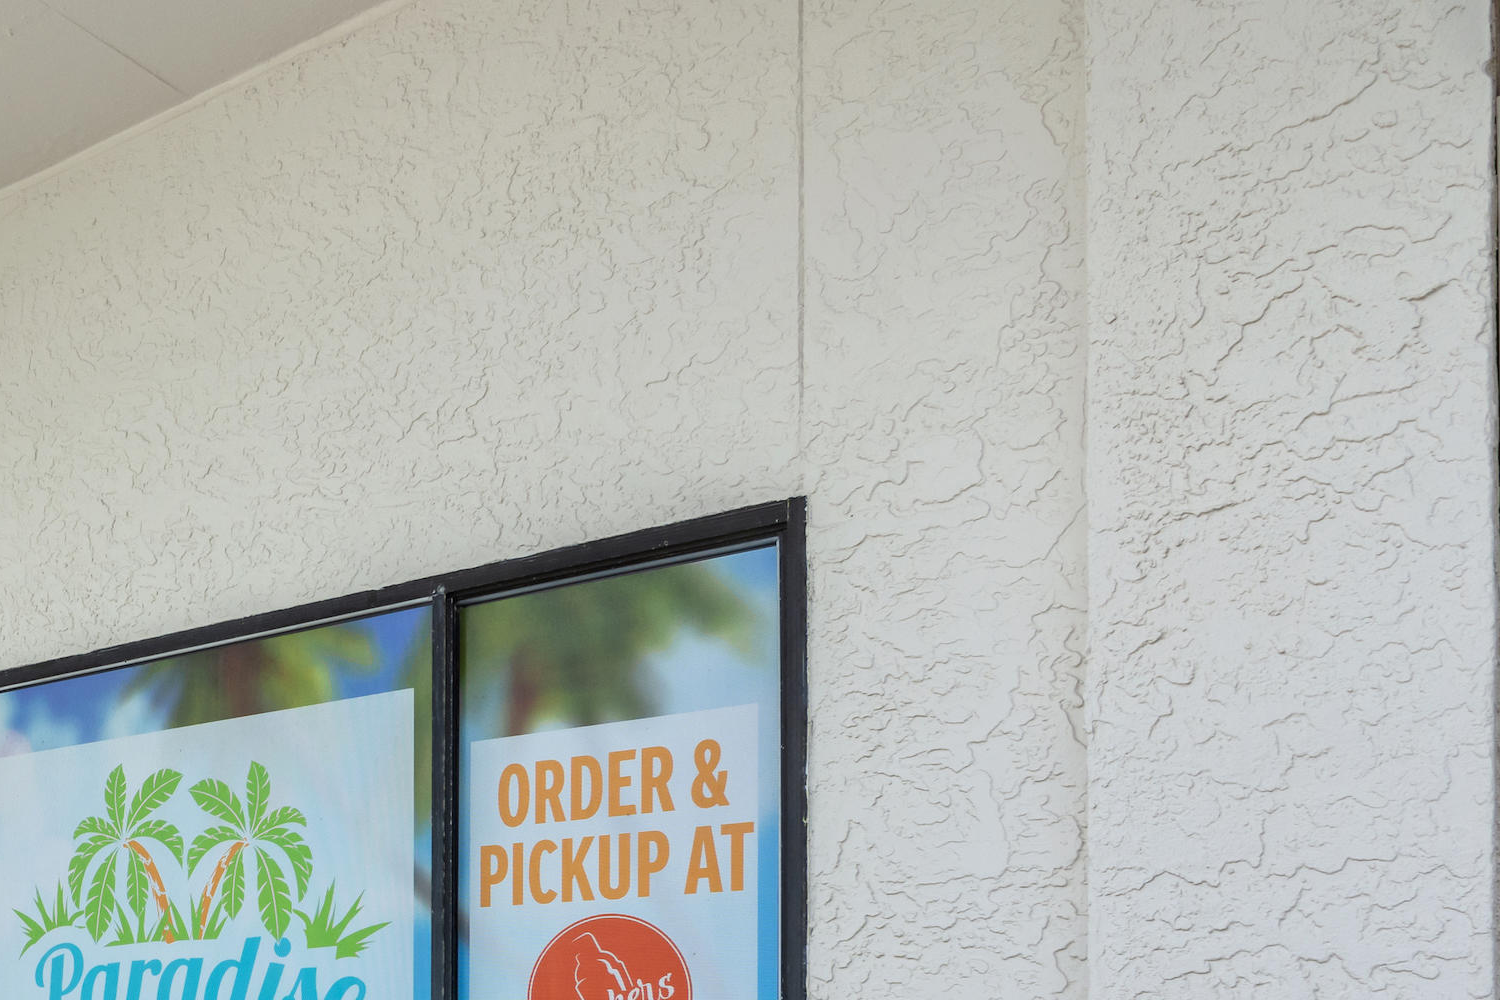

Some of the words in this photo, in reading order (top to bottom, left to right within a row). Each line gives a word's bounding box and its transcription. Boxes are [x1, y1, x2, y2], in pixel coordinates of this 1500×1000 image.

[497, 746, 675, 827] ORDER
[690, 739, 730, 809] &
[479, 830, 670, 908] PICKUP
[684, 821, 755, 895] AT
